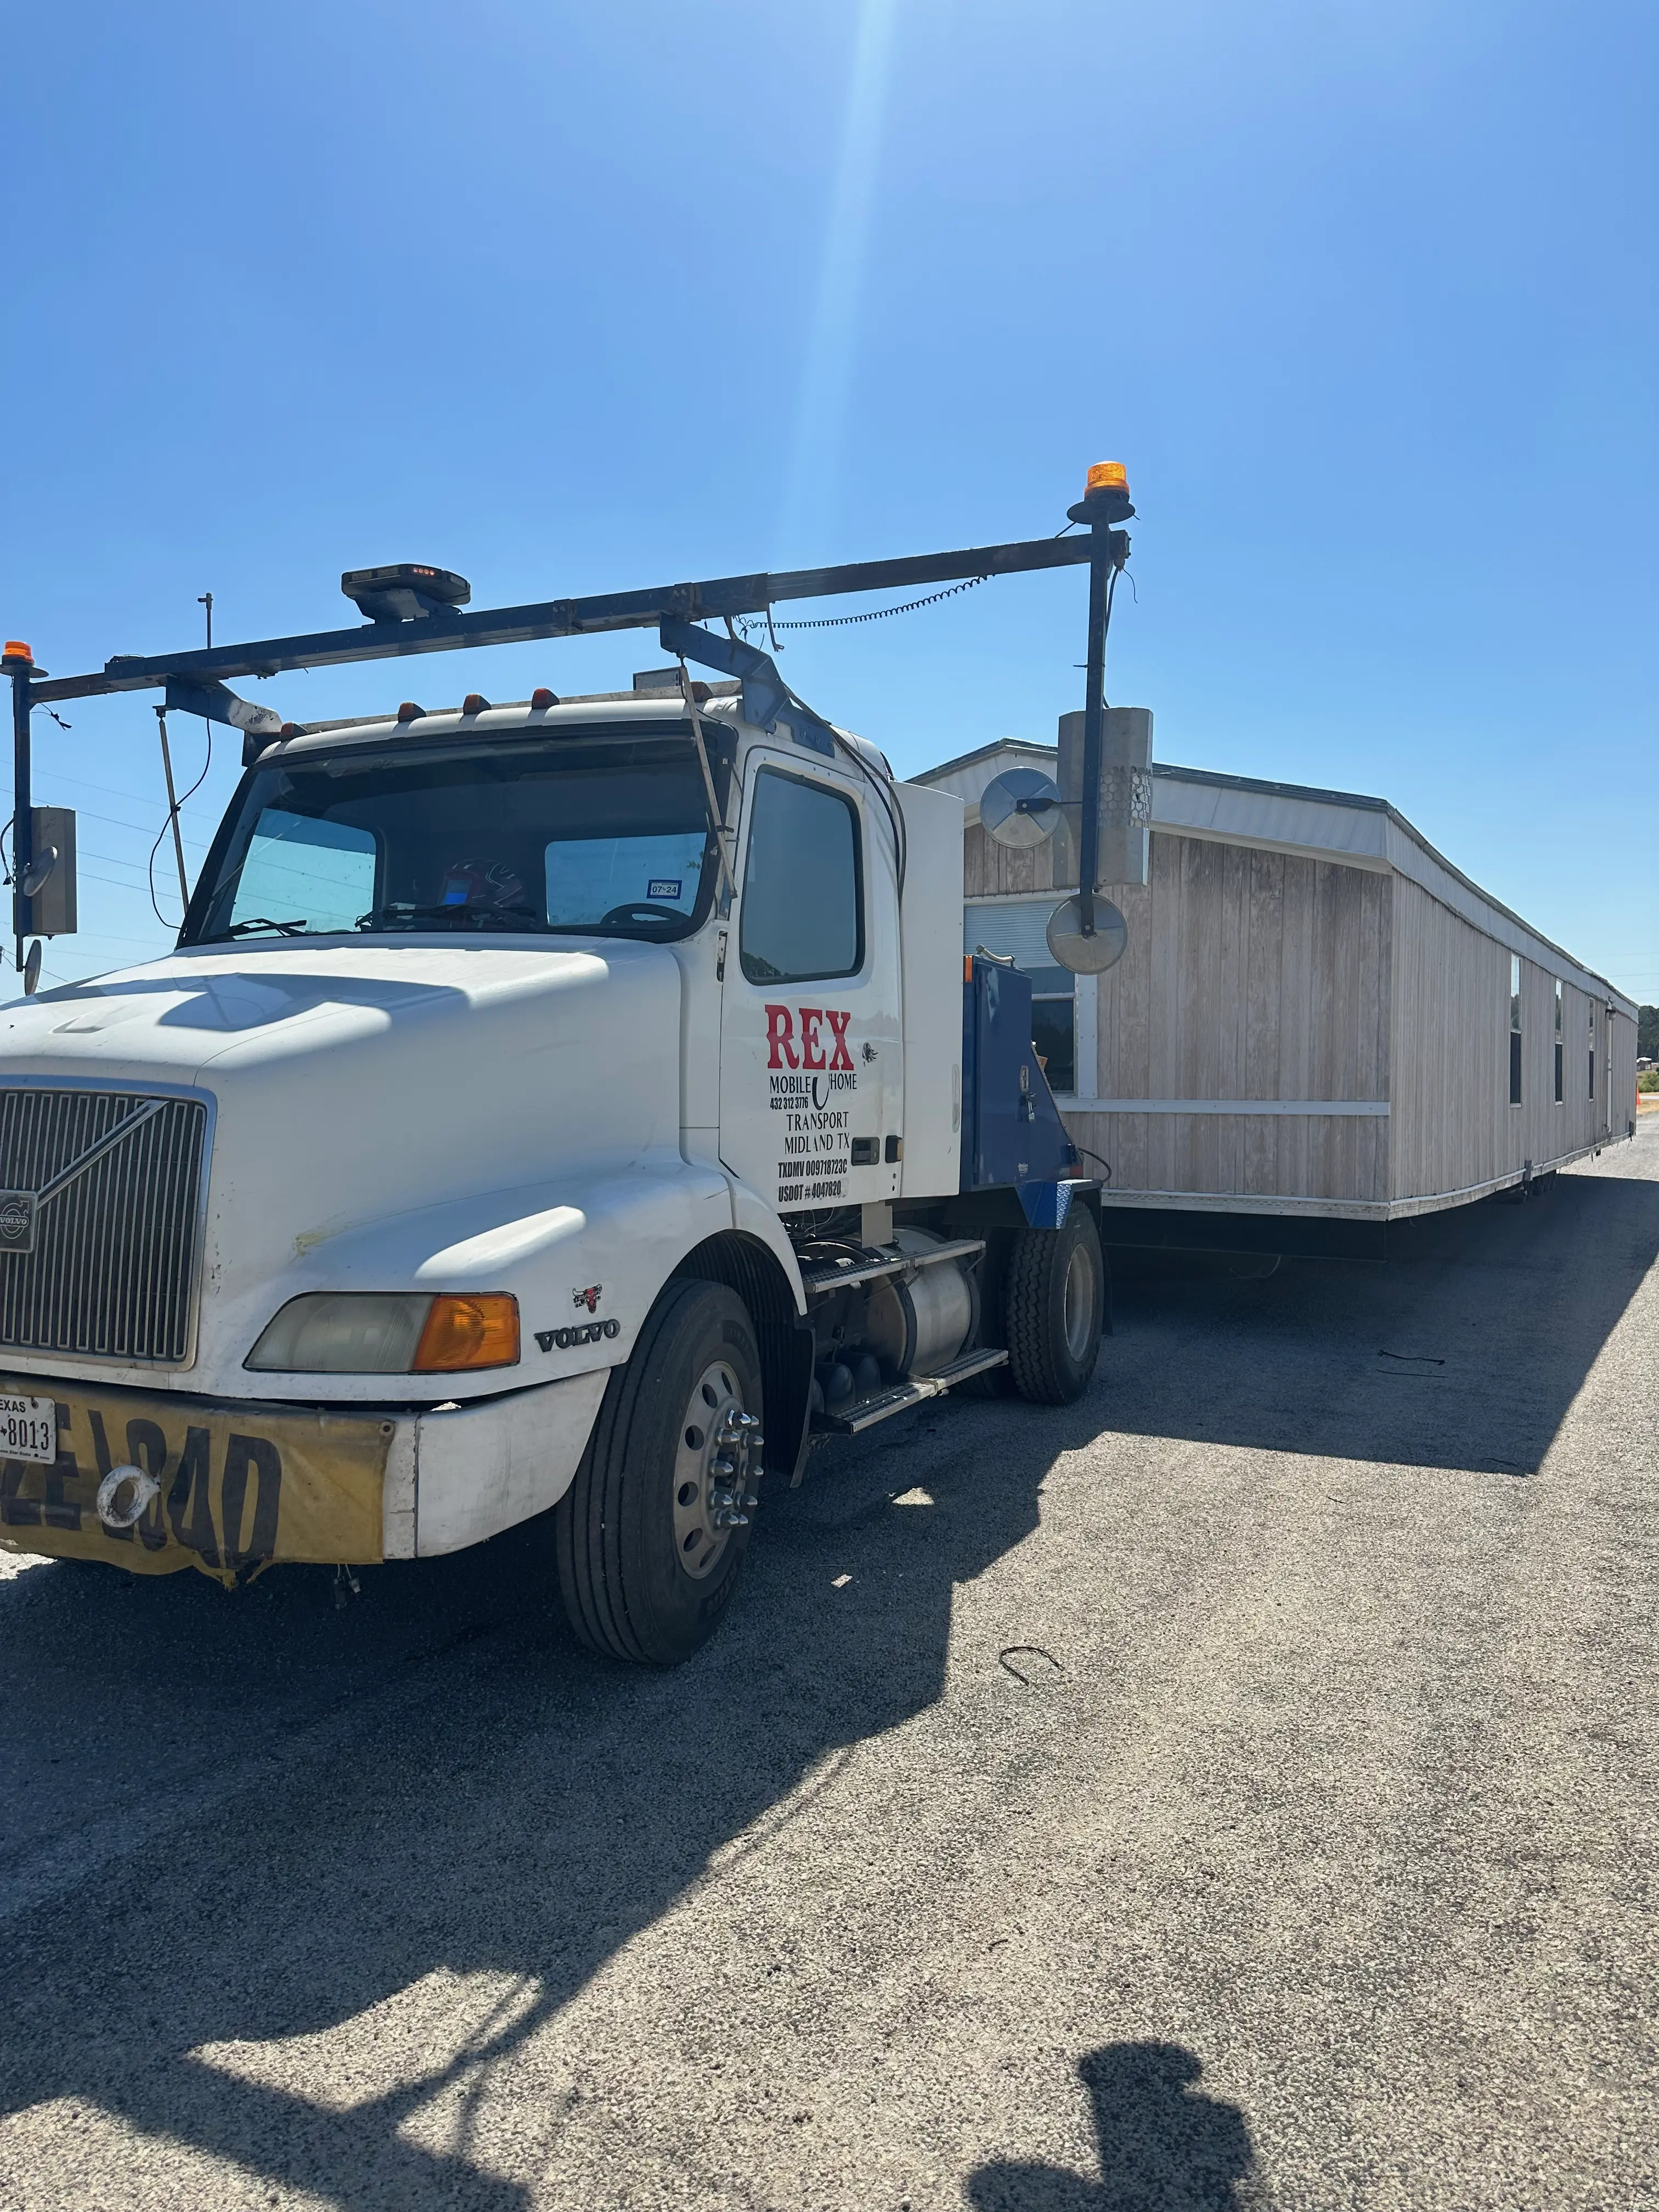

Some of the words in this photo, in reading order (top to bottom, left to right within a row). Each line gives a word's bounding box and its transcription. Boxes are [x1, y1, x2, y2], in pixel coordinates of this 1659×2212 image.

[765, 1005, 854, 1070] REX
[770, 1076, 811, 1093] MOBILE
[830, 1073, 857, 1090] HOME
[770, 1097, 782, 1110] 432
[783, 1097, 794, 1109] 312
[795, 1096, 809, 1109] 3776
[786, 1111, 849, 1131] TRANSPORT
[785, 1134, 833, 1154] MIDLAND
[837, 1132, 850, 1149] TX
[778, 1160, 805, 1178] TXDMV
[806, 1159, 847, 1176] 009718723C
[778, 1184, 804, 1202] USDOT
[534, 1319, 620, 1352] VOLVO
[0, 1400, 26, 1413] EXAS
